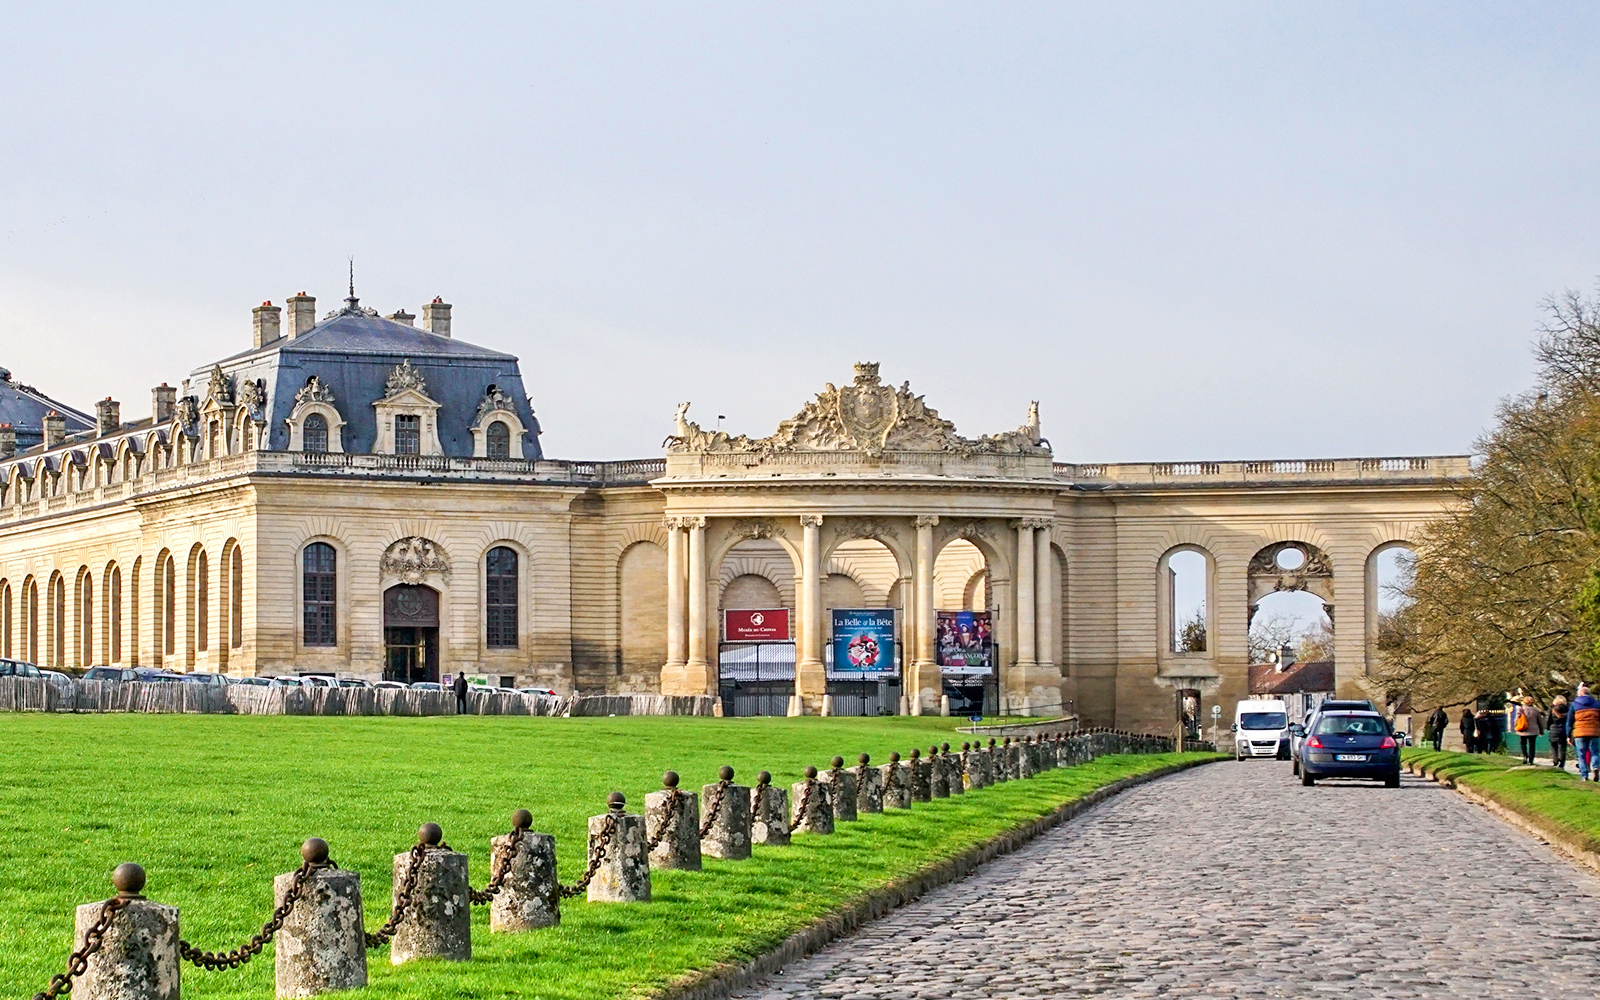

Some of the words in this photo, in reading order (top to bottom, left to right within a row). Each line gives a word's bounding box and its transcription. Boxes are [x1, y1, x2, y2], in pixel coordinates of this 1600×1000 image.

[844, 617, 862, 626] Belle
[868, 617, 876, 626] la
[876, 617, 893, 626] Bête
